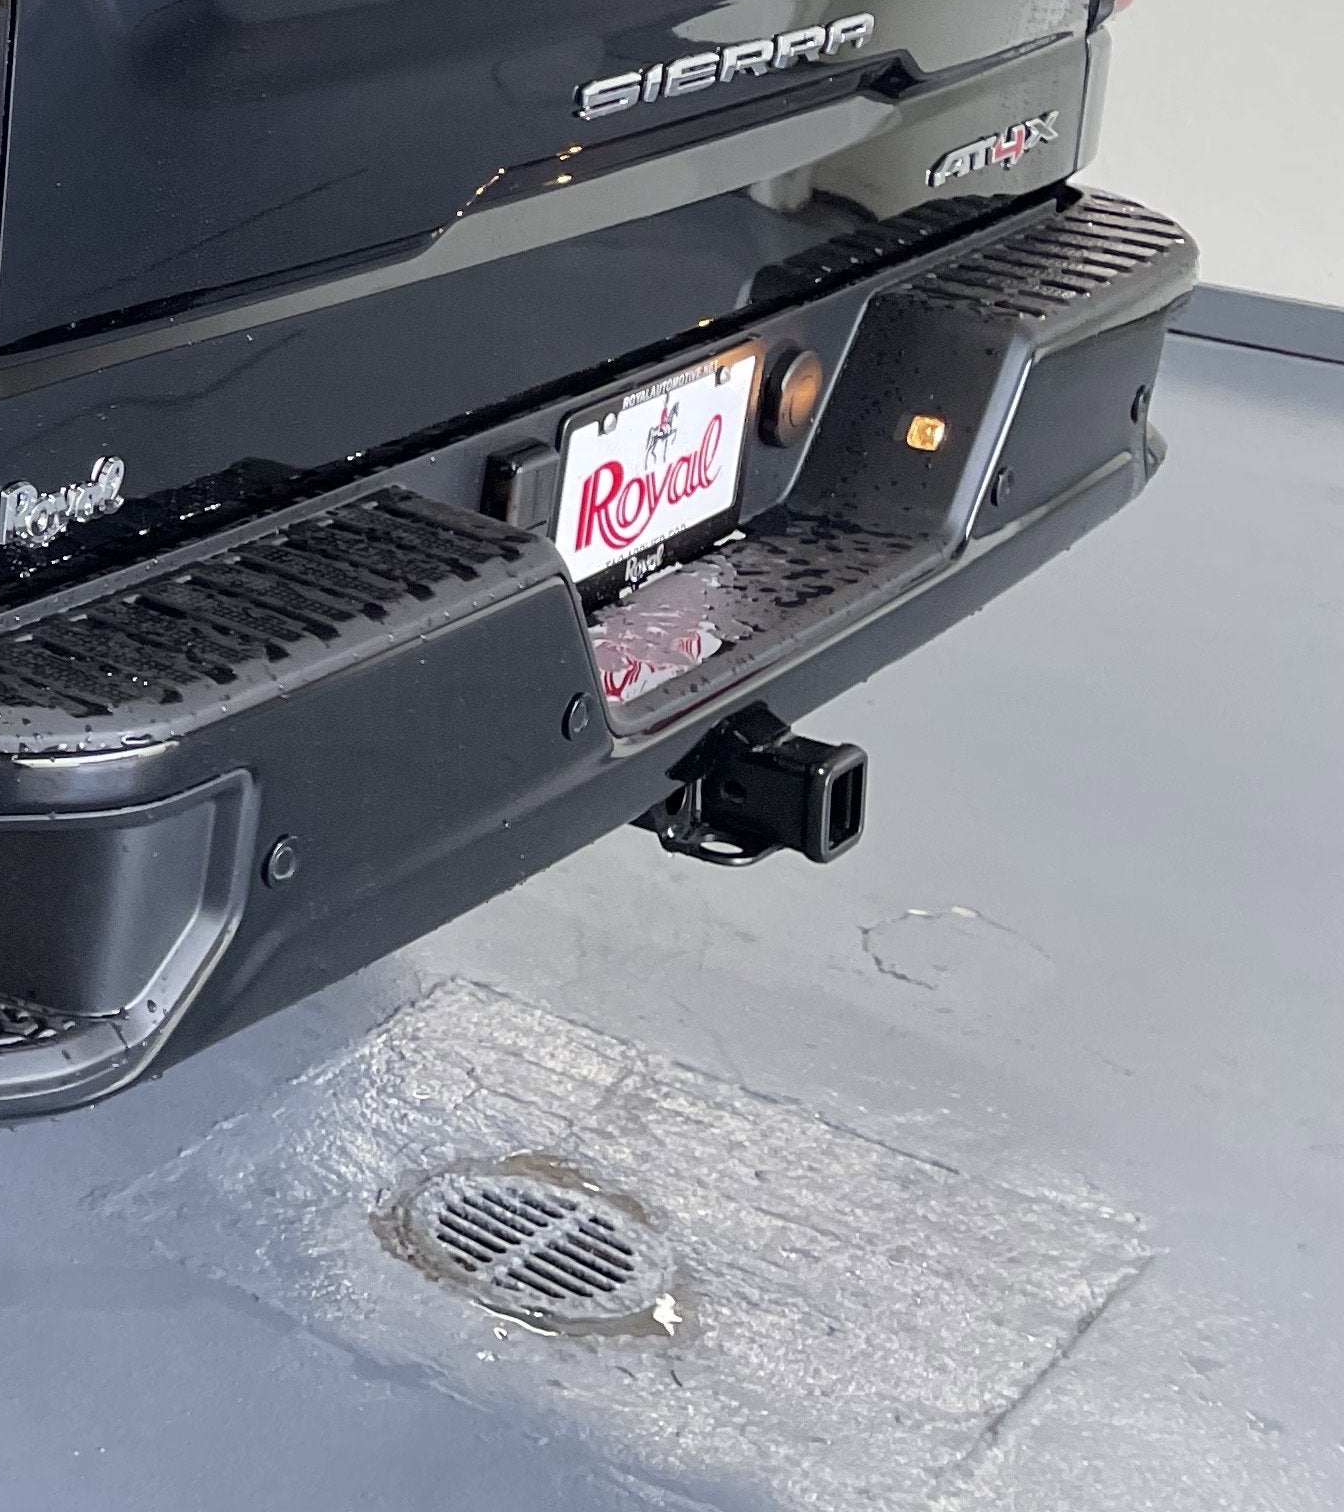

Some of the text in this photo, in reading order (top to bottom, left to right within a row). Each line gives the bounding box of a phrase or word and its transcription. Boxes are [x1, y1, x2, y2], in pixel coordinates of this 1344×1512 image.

[573, 11, 875, 121] SIERRA
[925, 110, 1060, 188] AT4X
[575, 414, 722, 553] Royal
